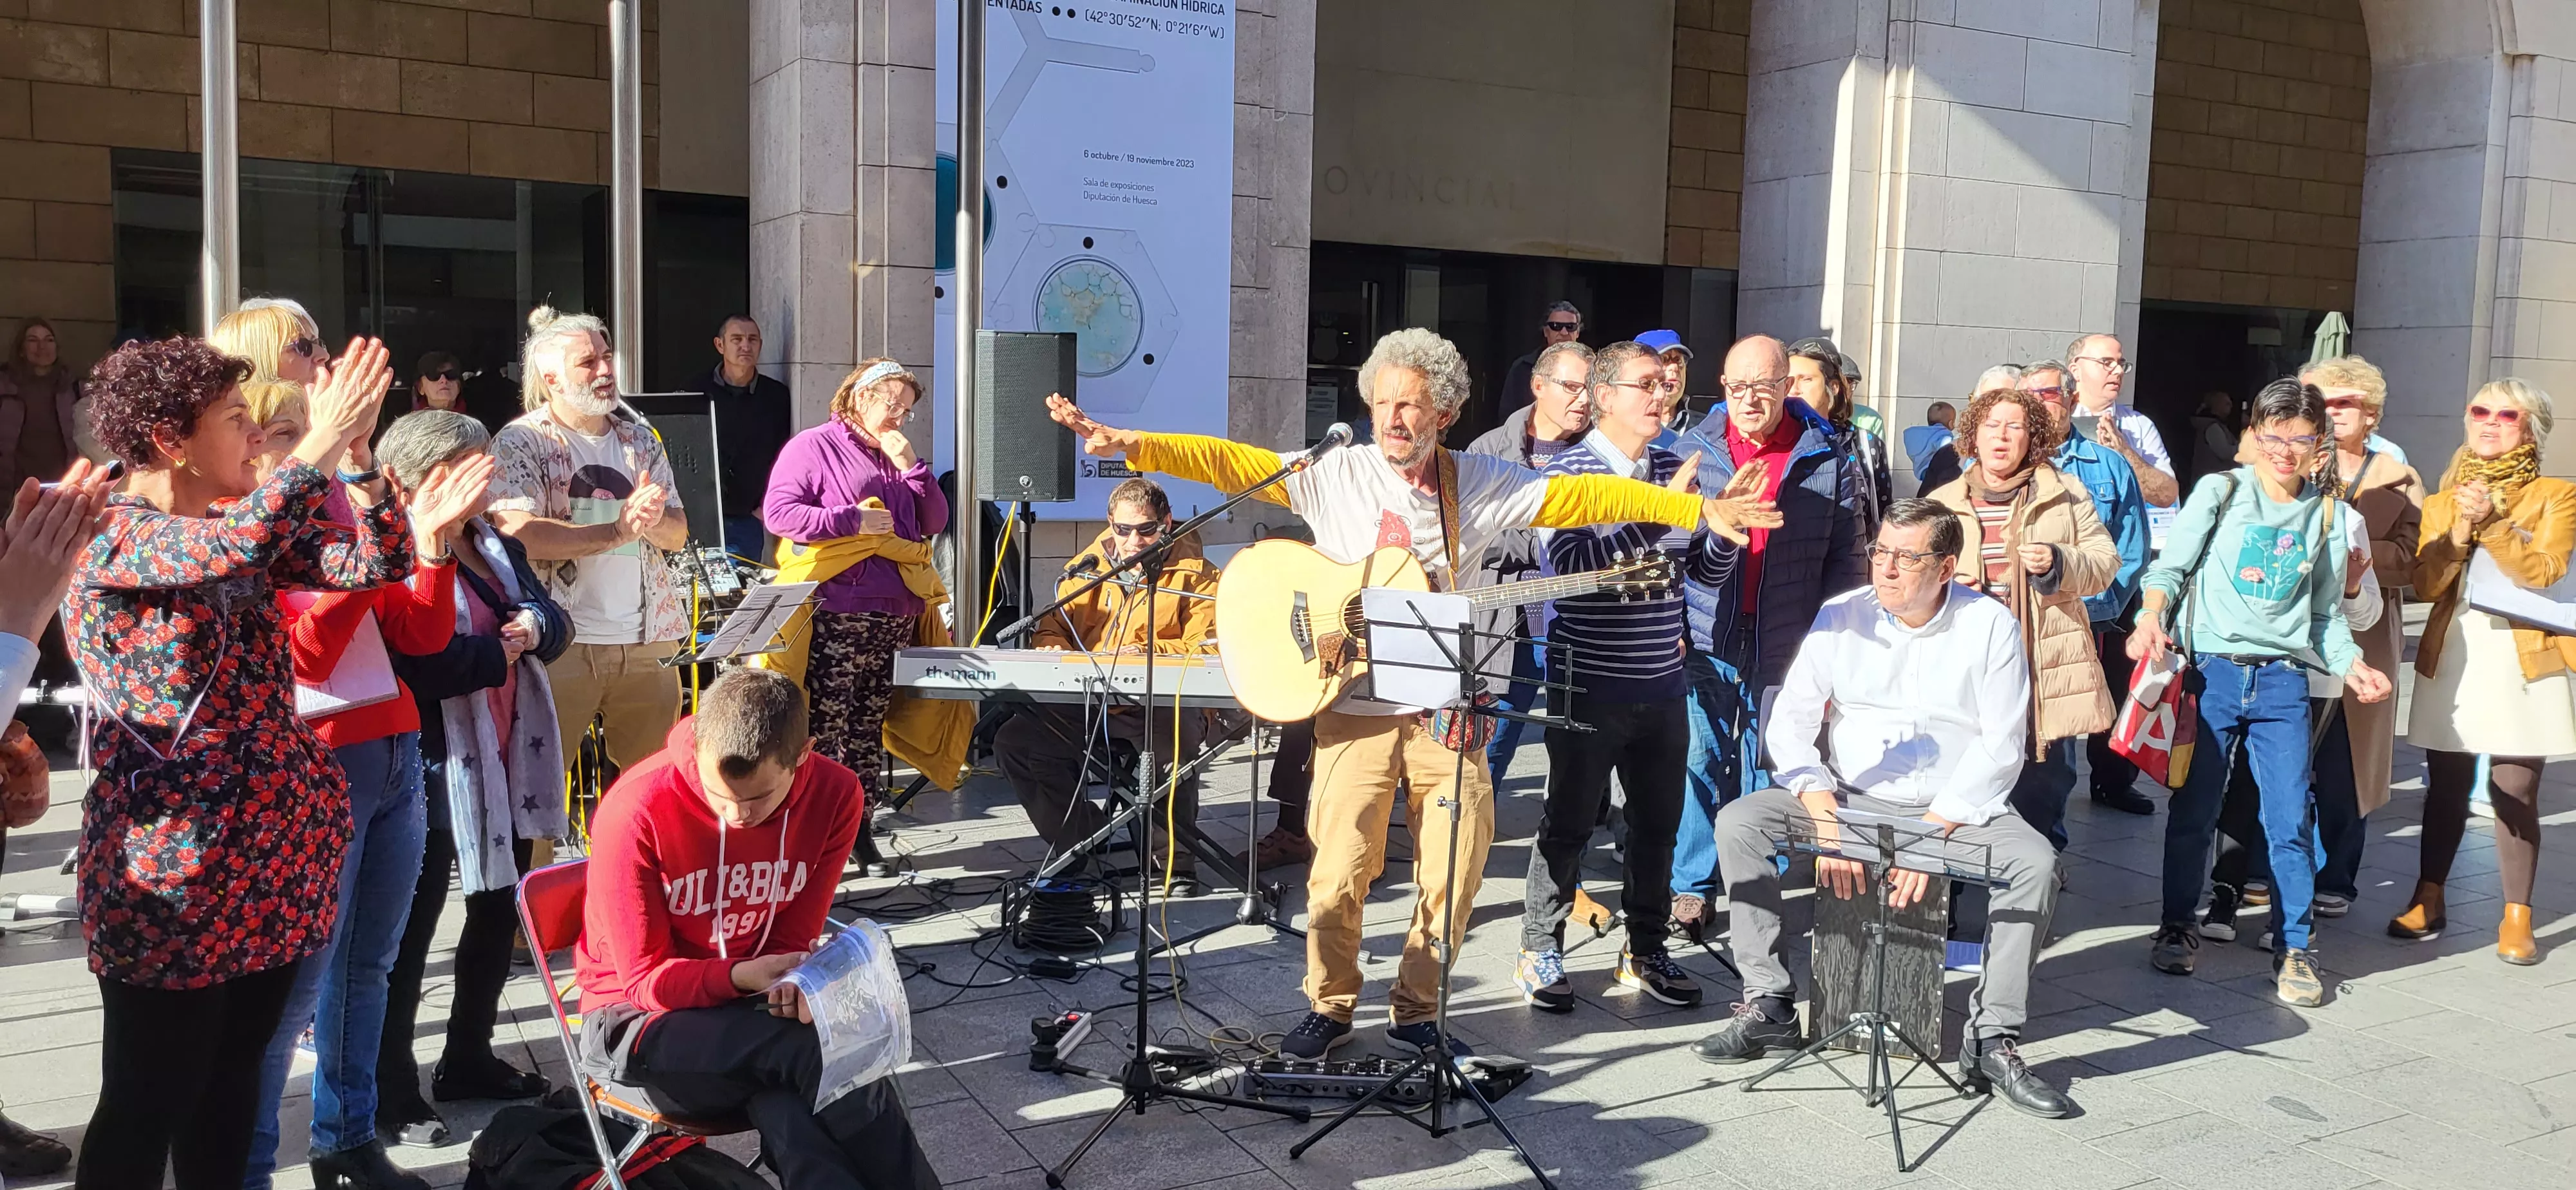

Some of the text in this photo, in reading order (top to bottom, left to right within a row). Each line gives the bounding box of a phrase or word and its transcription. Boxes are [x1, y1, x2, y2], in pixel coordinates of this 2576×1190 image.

[1083, 149, 1089, 158] 6
[1090, 151, 1119, 161] octubre
[1127, 154, 1135, 162] 19
[1136, 156, 1175, 167] noviembre
[1176, 158, 1195, 168] 2023
[1083, 177, 1155, 192] Sala de exposiciones
[1083, 191, 1158, 205] Diputación de Huesca
